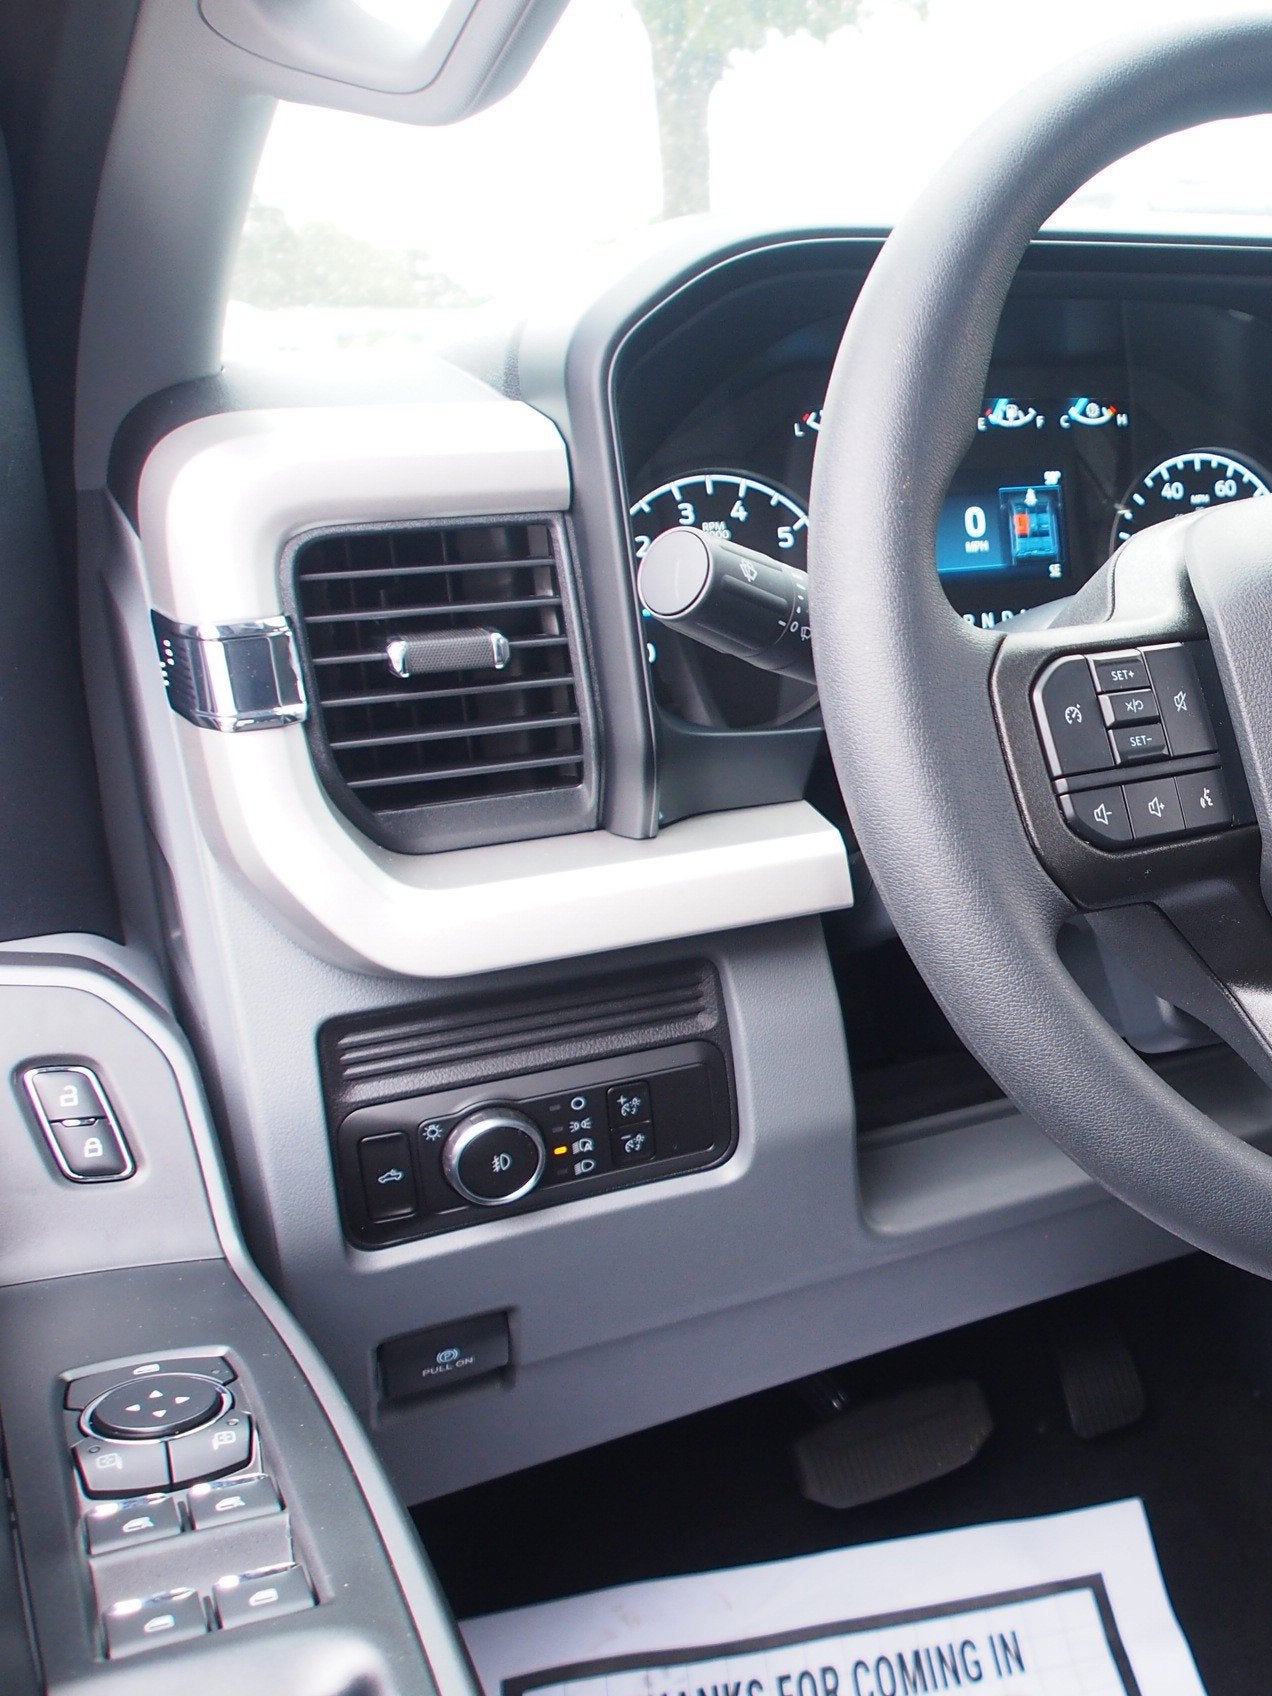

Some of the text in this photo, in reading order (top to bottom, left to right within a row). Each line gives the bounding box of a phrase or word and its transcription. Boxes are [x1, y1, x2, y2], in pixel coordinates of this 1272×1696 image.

[977, 417, 988, 432] E
[1035, 414, 1045, 429] F
[1059, 414, 1071, 429] C
[1116, 413, 1129, 427] H
[1161, 481, 1185, 500] 40
[1214, 479, 1238, 498] 60
[677, 502, 696, 526] 3
[730, 500, 749, 522] 4
[702, 520, 728, 534] RPM
[964, 505, 986, 538] 0
[777, 526, 795, 548] 5
[965, 540, 990, 553] MPH
[981, 611, 995, 629] N
[1111, 670, 1135, 681] SET+
[422, 1356, 474, 1377] PULL ON
[853, 1639, 983, 1696] COMING
[988, 1630, 1026, 1678] IN
